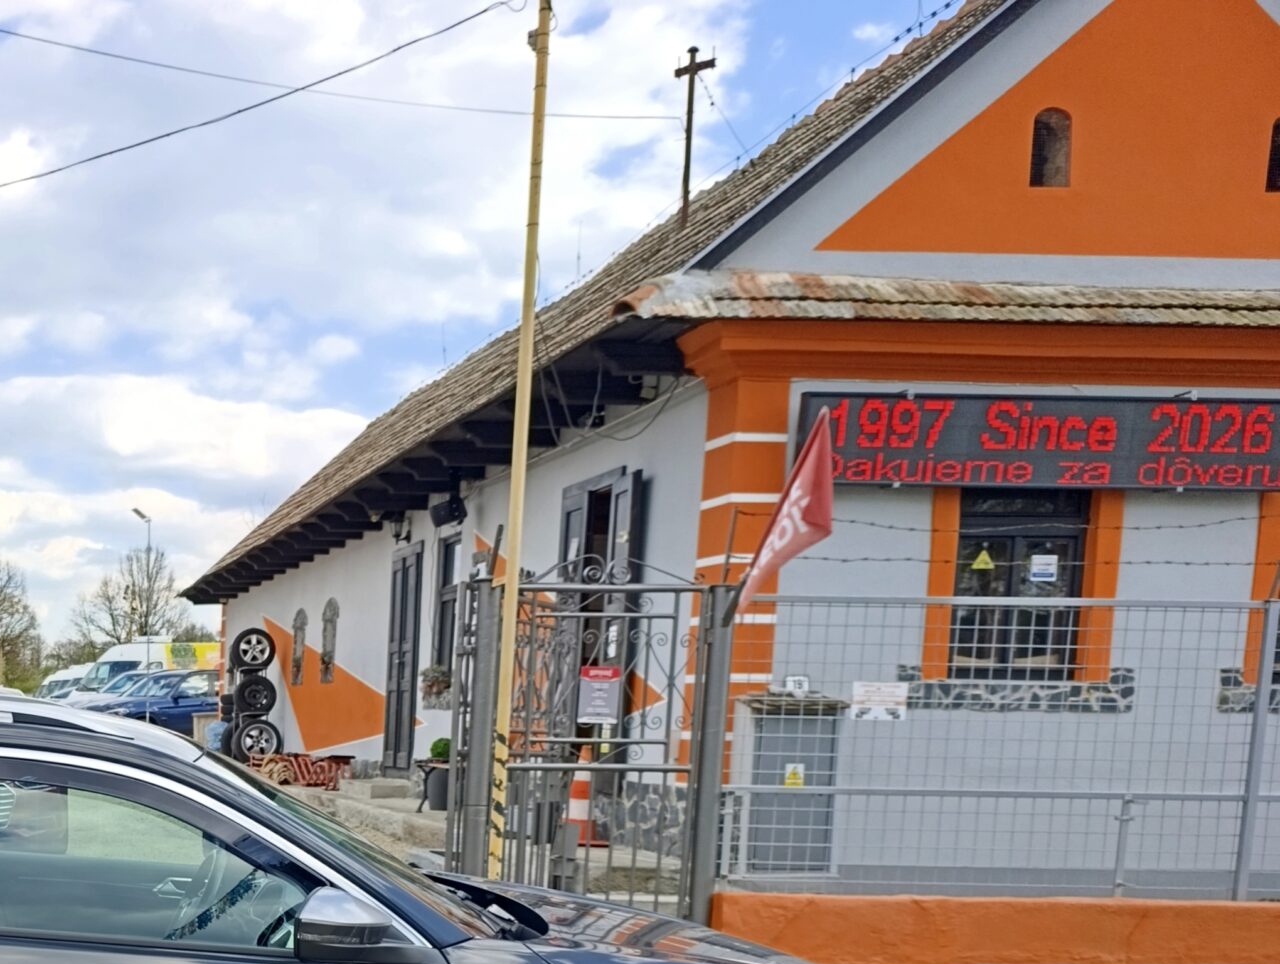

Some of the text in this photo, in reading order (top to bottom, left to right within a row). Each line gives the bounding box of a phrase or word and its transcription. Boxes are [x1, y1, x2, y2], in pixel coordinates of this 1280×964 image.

[831, 399, 1275, 454] 1997 Since 2026
[1056, 461, 1111, 485] za
